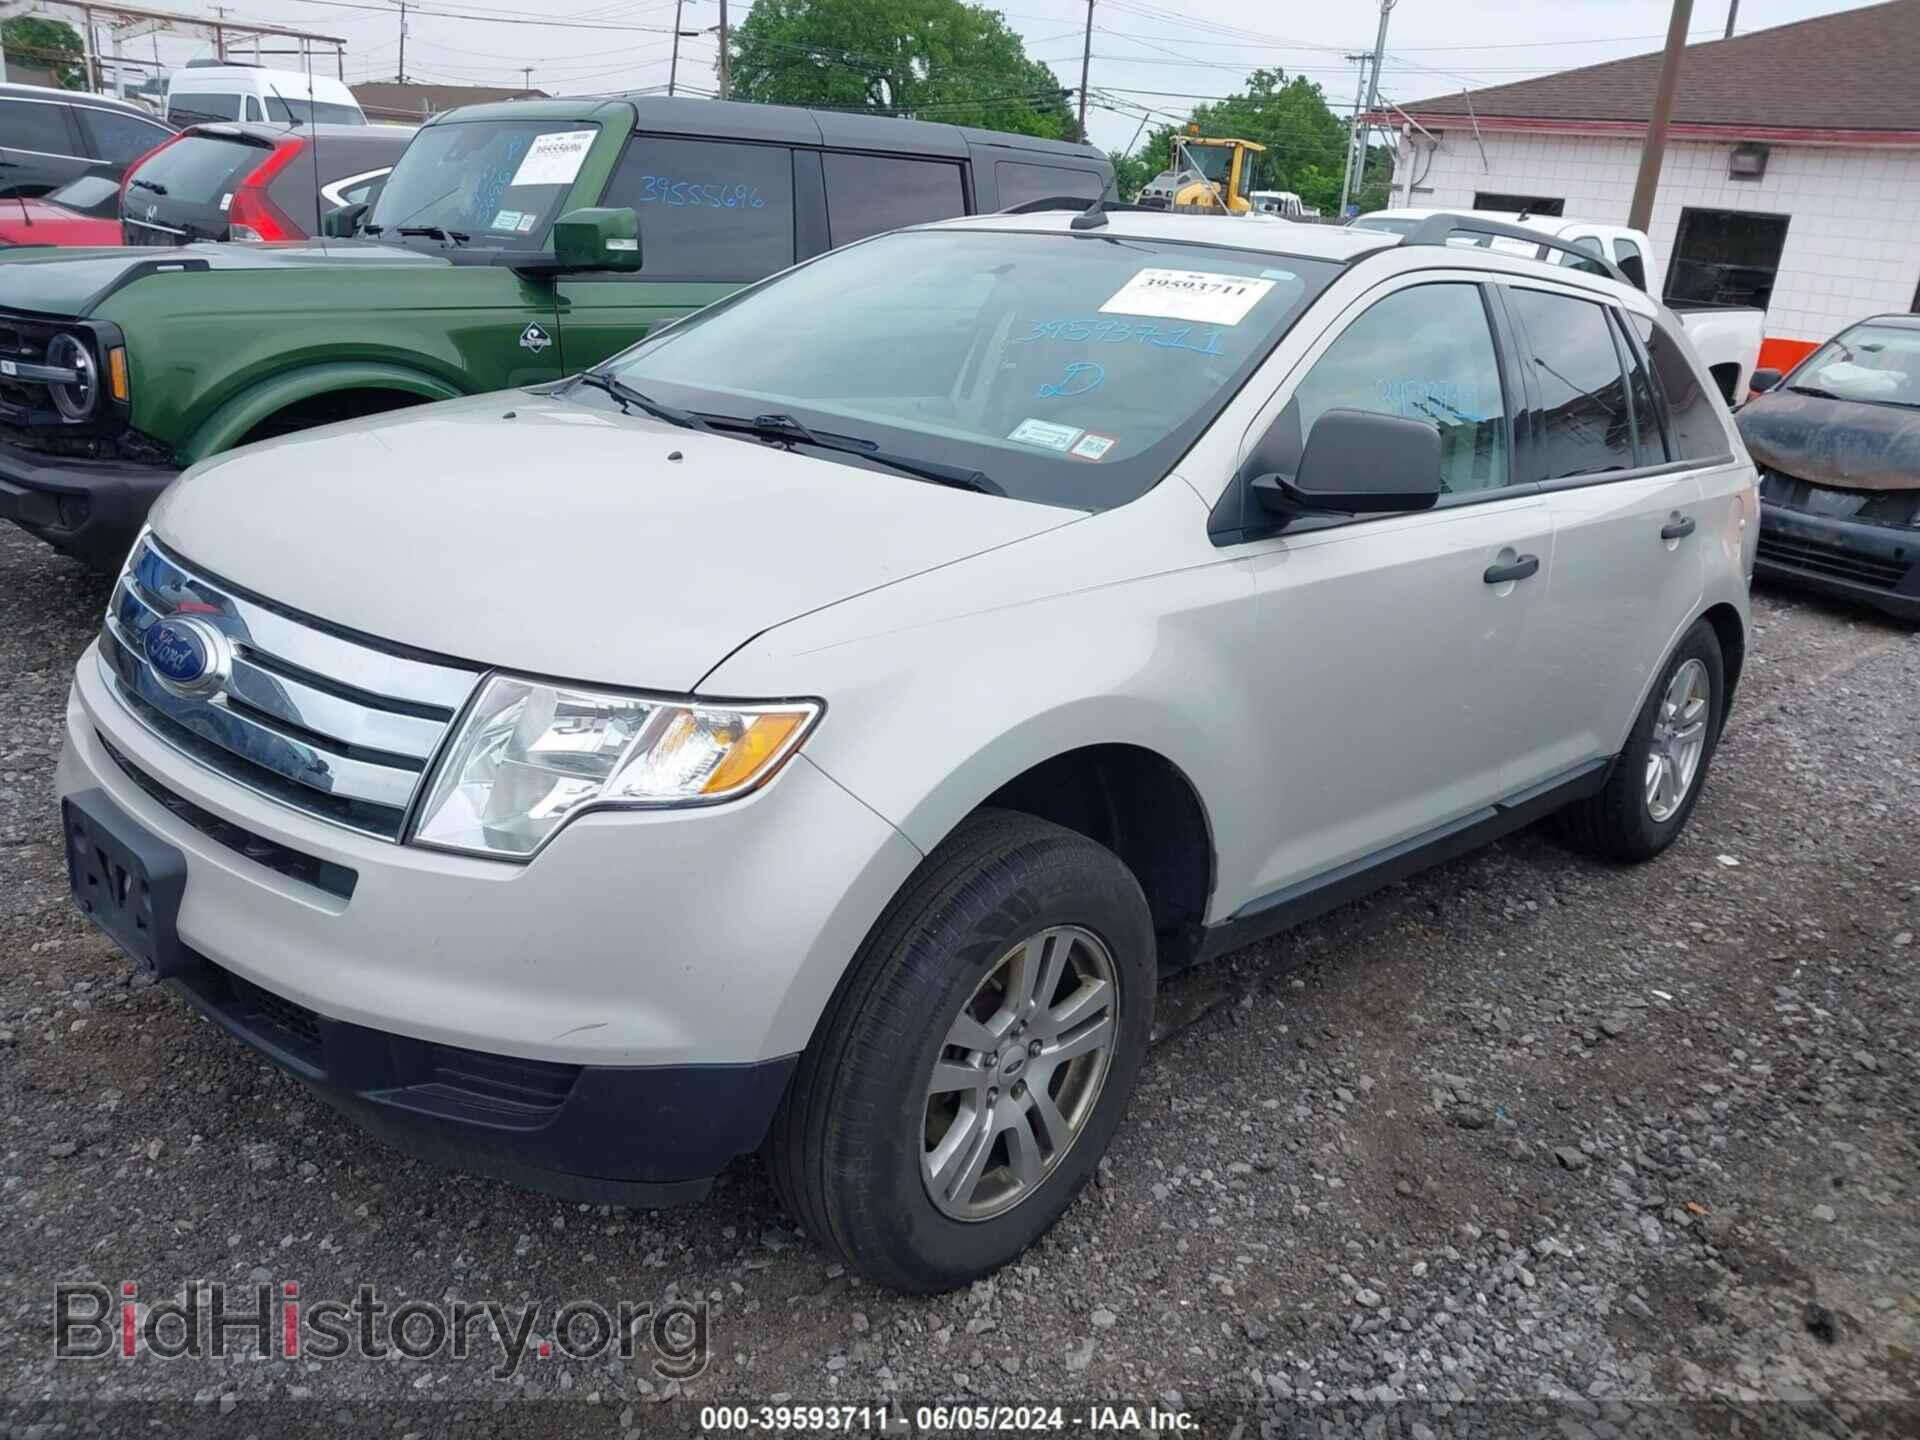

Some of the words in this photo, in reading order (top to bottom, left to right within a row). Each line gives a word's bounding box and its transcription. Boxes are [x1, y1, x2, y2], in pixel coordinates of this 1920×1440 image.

[640, 175, 767, 208] 39555696
[1140, 277, 1247, 296] 39593711
[150, 626, 193, 670] Ford
